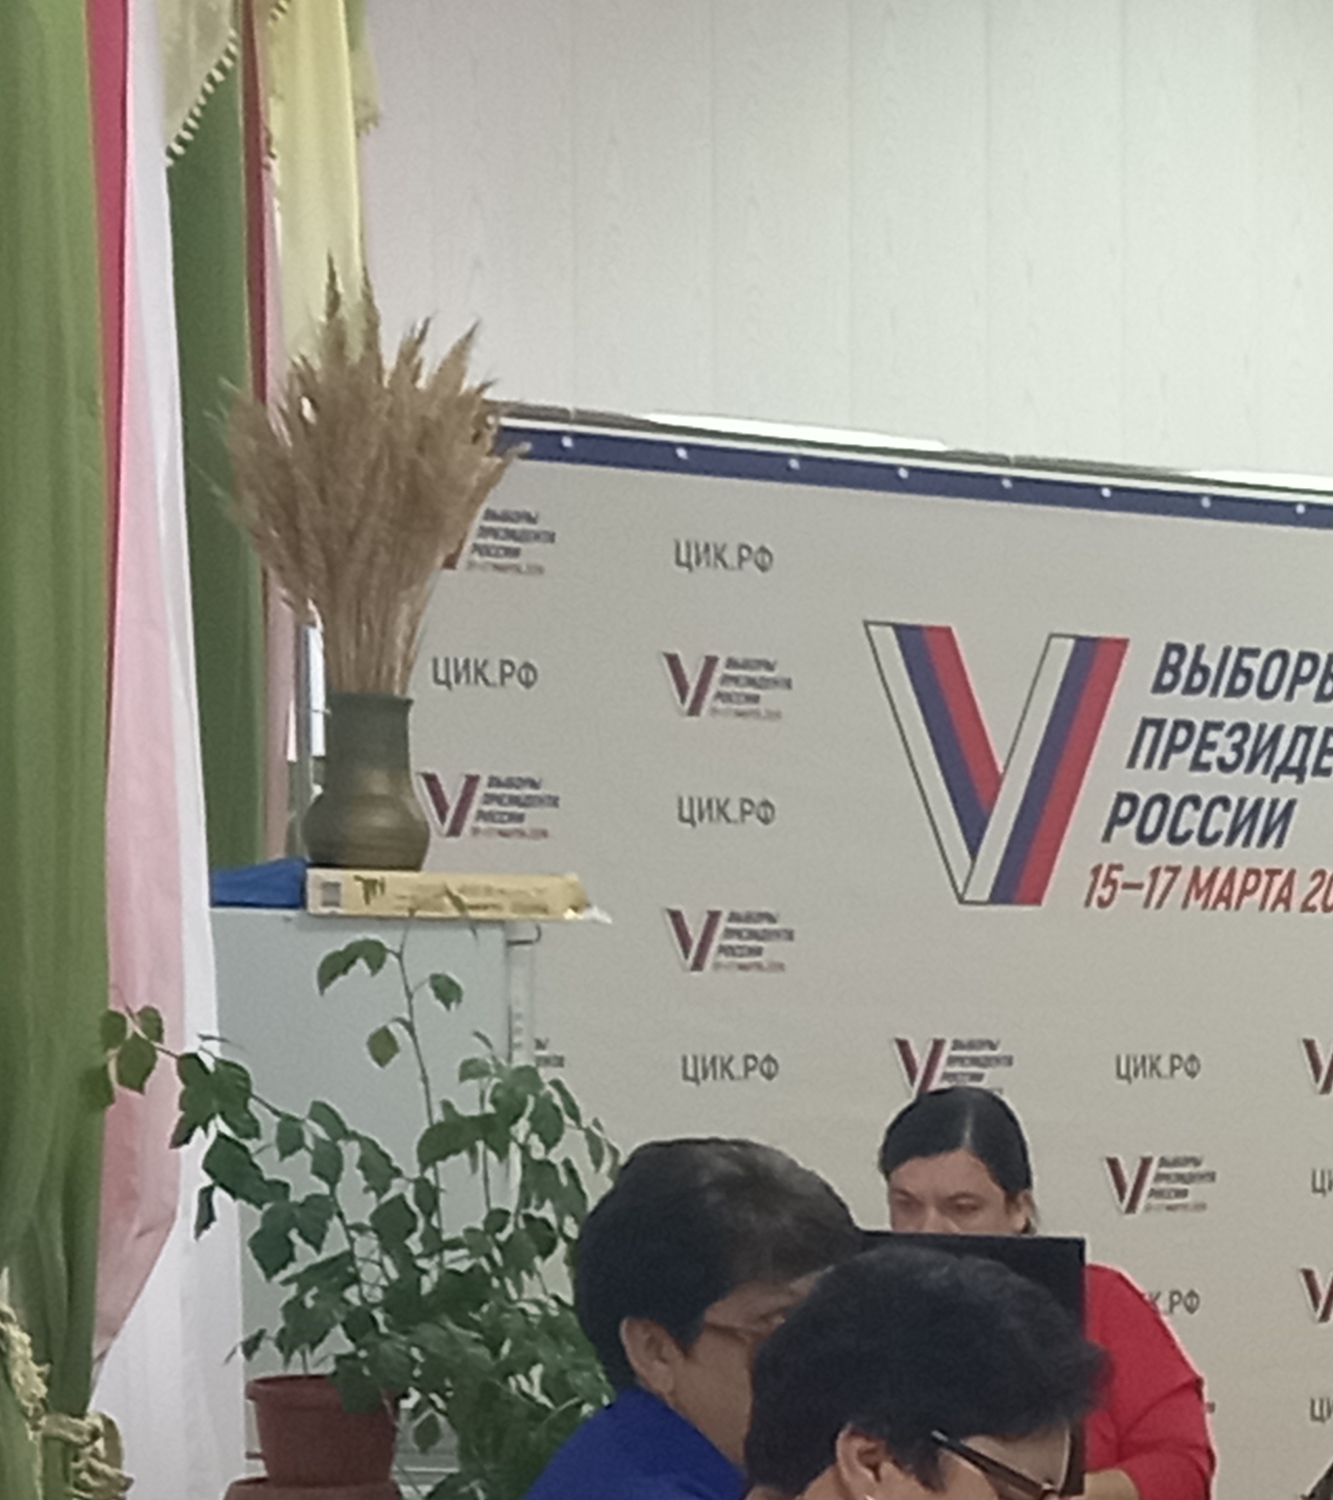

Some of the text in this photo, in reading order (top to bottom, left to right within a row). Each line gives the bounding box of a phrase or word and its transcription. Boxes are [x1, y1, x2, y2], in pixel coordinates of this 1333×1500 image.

[674, 539, 773, 573] ЦИК.РФ
[432, 657, 538, 691] ЦИК.РФ
[678, 796, 775, 828] ЦИК.РФ
[1101, 791, 1297, 849] РОССИИ
[1180, 865, 1295, 913] МАРТА
[682, 1054, 779, 1086] ЦИК.РФ
[1116, 1054, 1201, 1084] ЦИК.РФ
